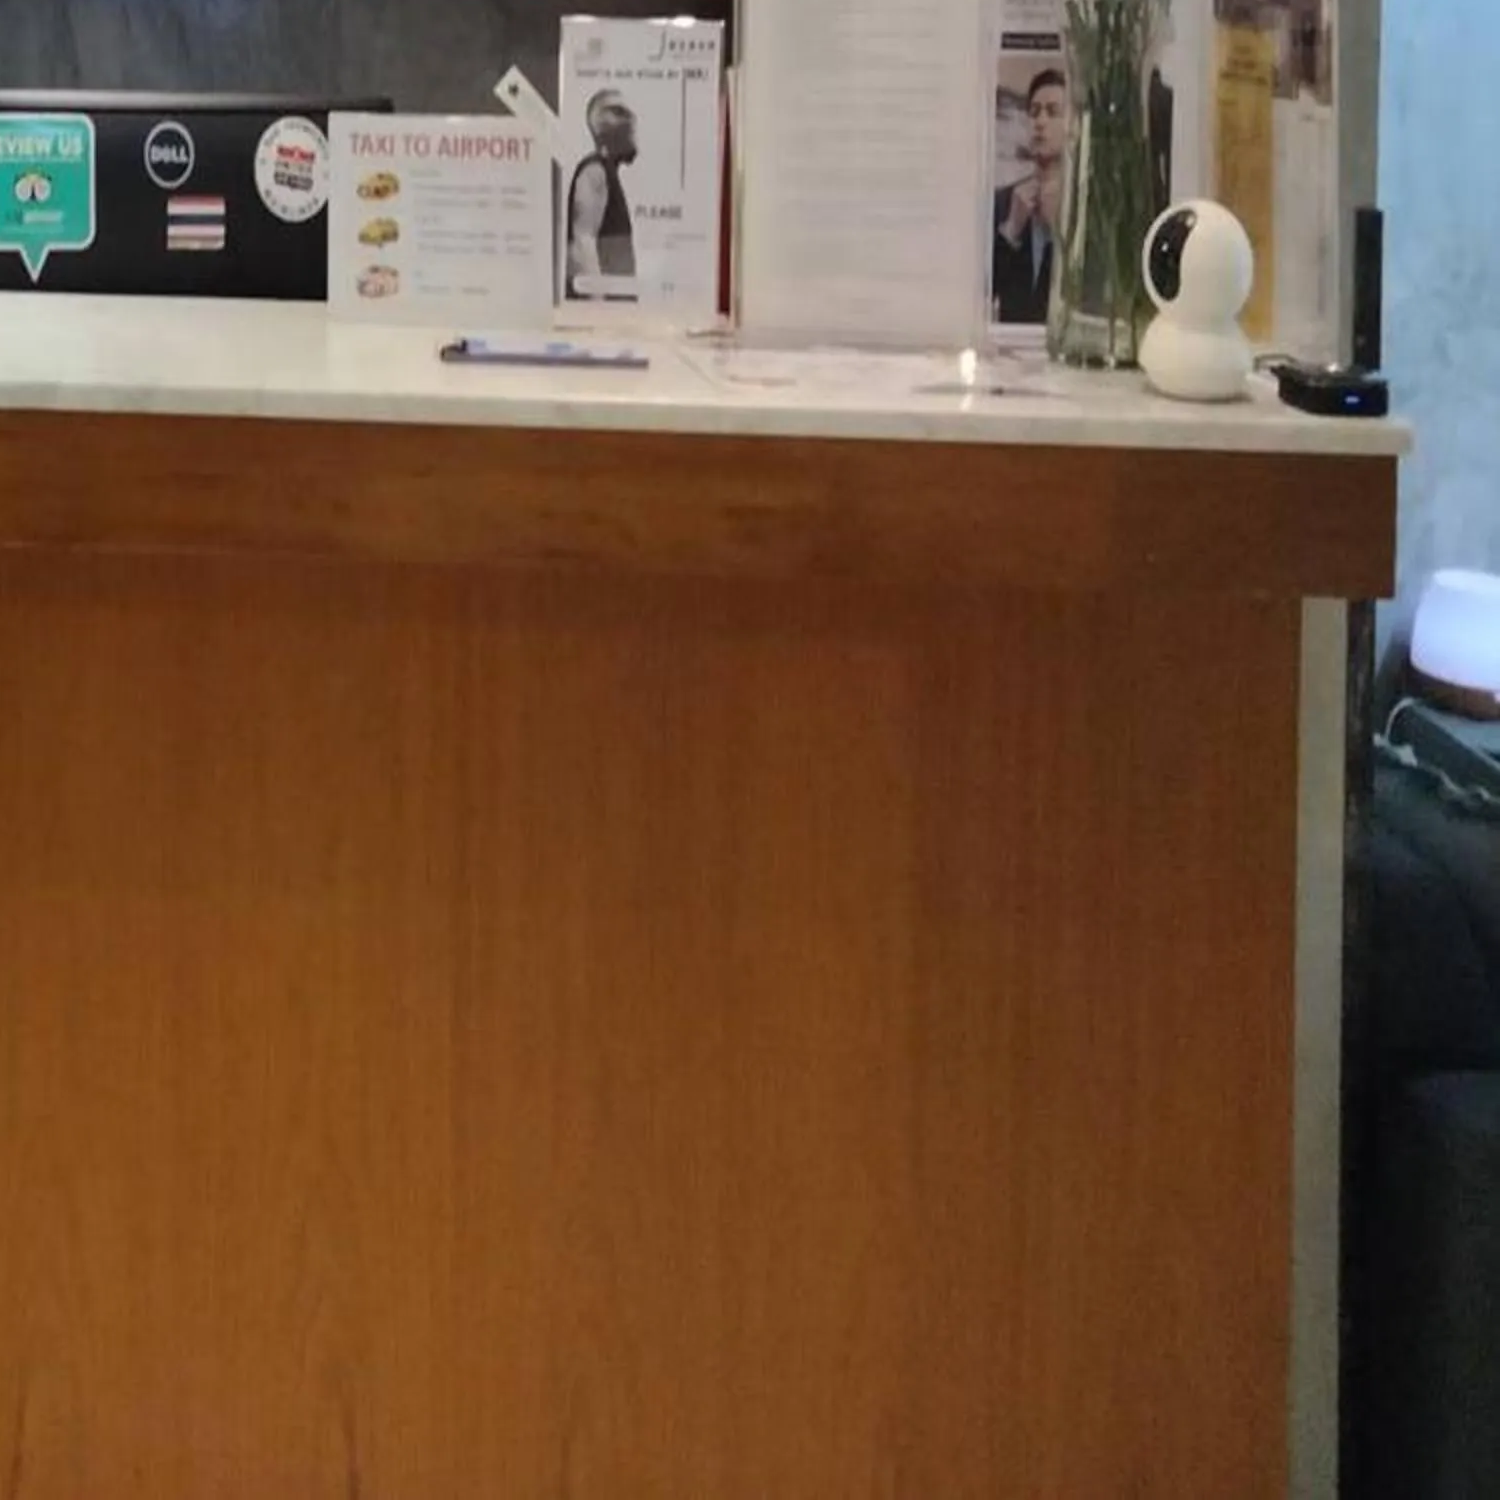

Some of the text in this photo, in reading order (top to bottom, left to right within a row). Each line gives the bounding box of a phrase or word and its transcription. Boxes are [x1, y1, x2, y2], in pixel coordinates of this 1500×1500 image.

[57, 134, 84, 157] US
[150, 144, 189, 165] DELL
[349, 133, 395, 158] TAXI
[402, 134, 431, 158] TO
[437, 135, 534, 162] AIRPORT
